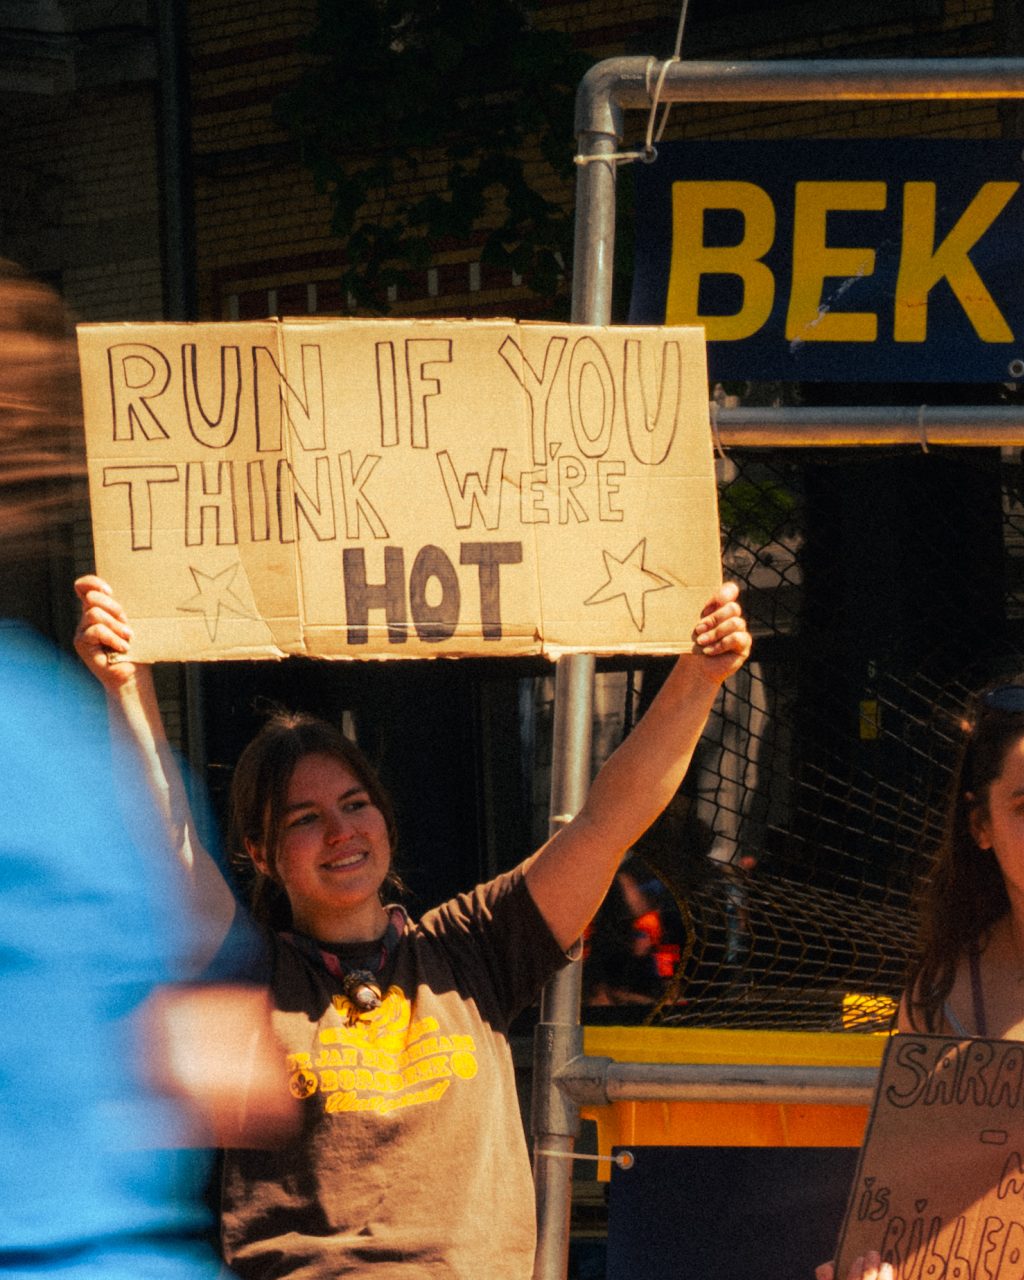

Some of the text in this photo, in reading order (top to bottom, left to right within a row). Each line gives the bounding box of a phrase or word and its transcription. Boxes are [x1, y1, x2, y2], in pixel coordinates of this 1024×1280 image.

[107, 334, 681, 466] RUN IF YOU
[103, 450, 390, 551] THINK
[342, 541, 523, 645] HOT
